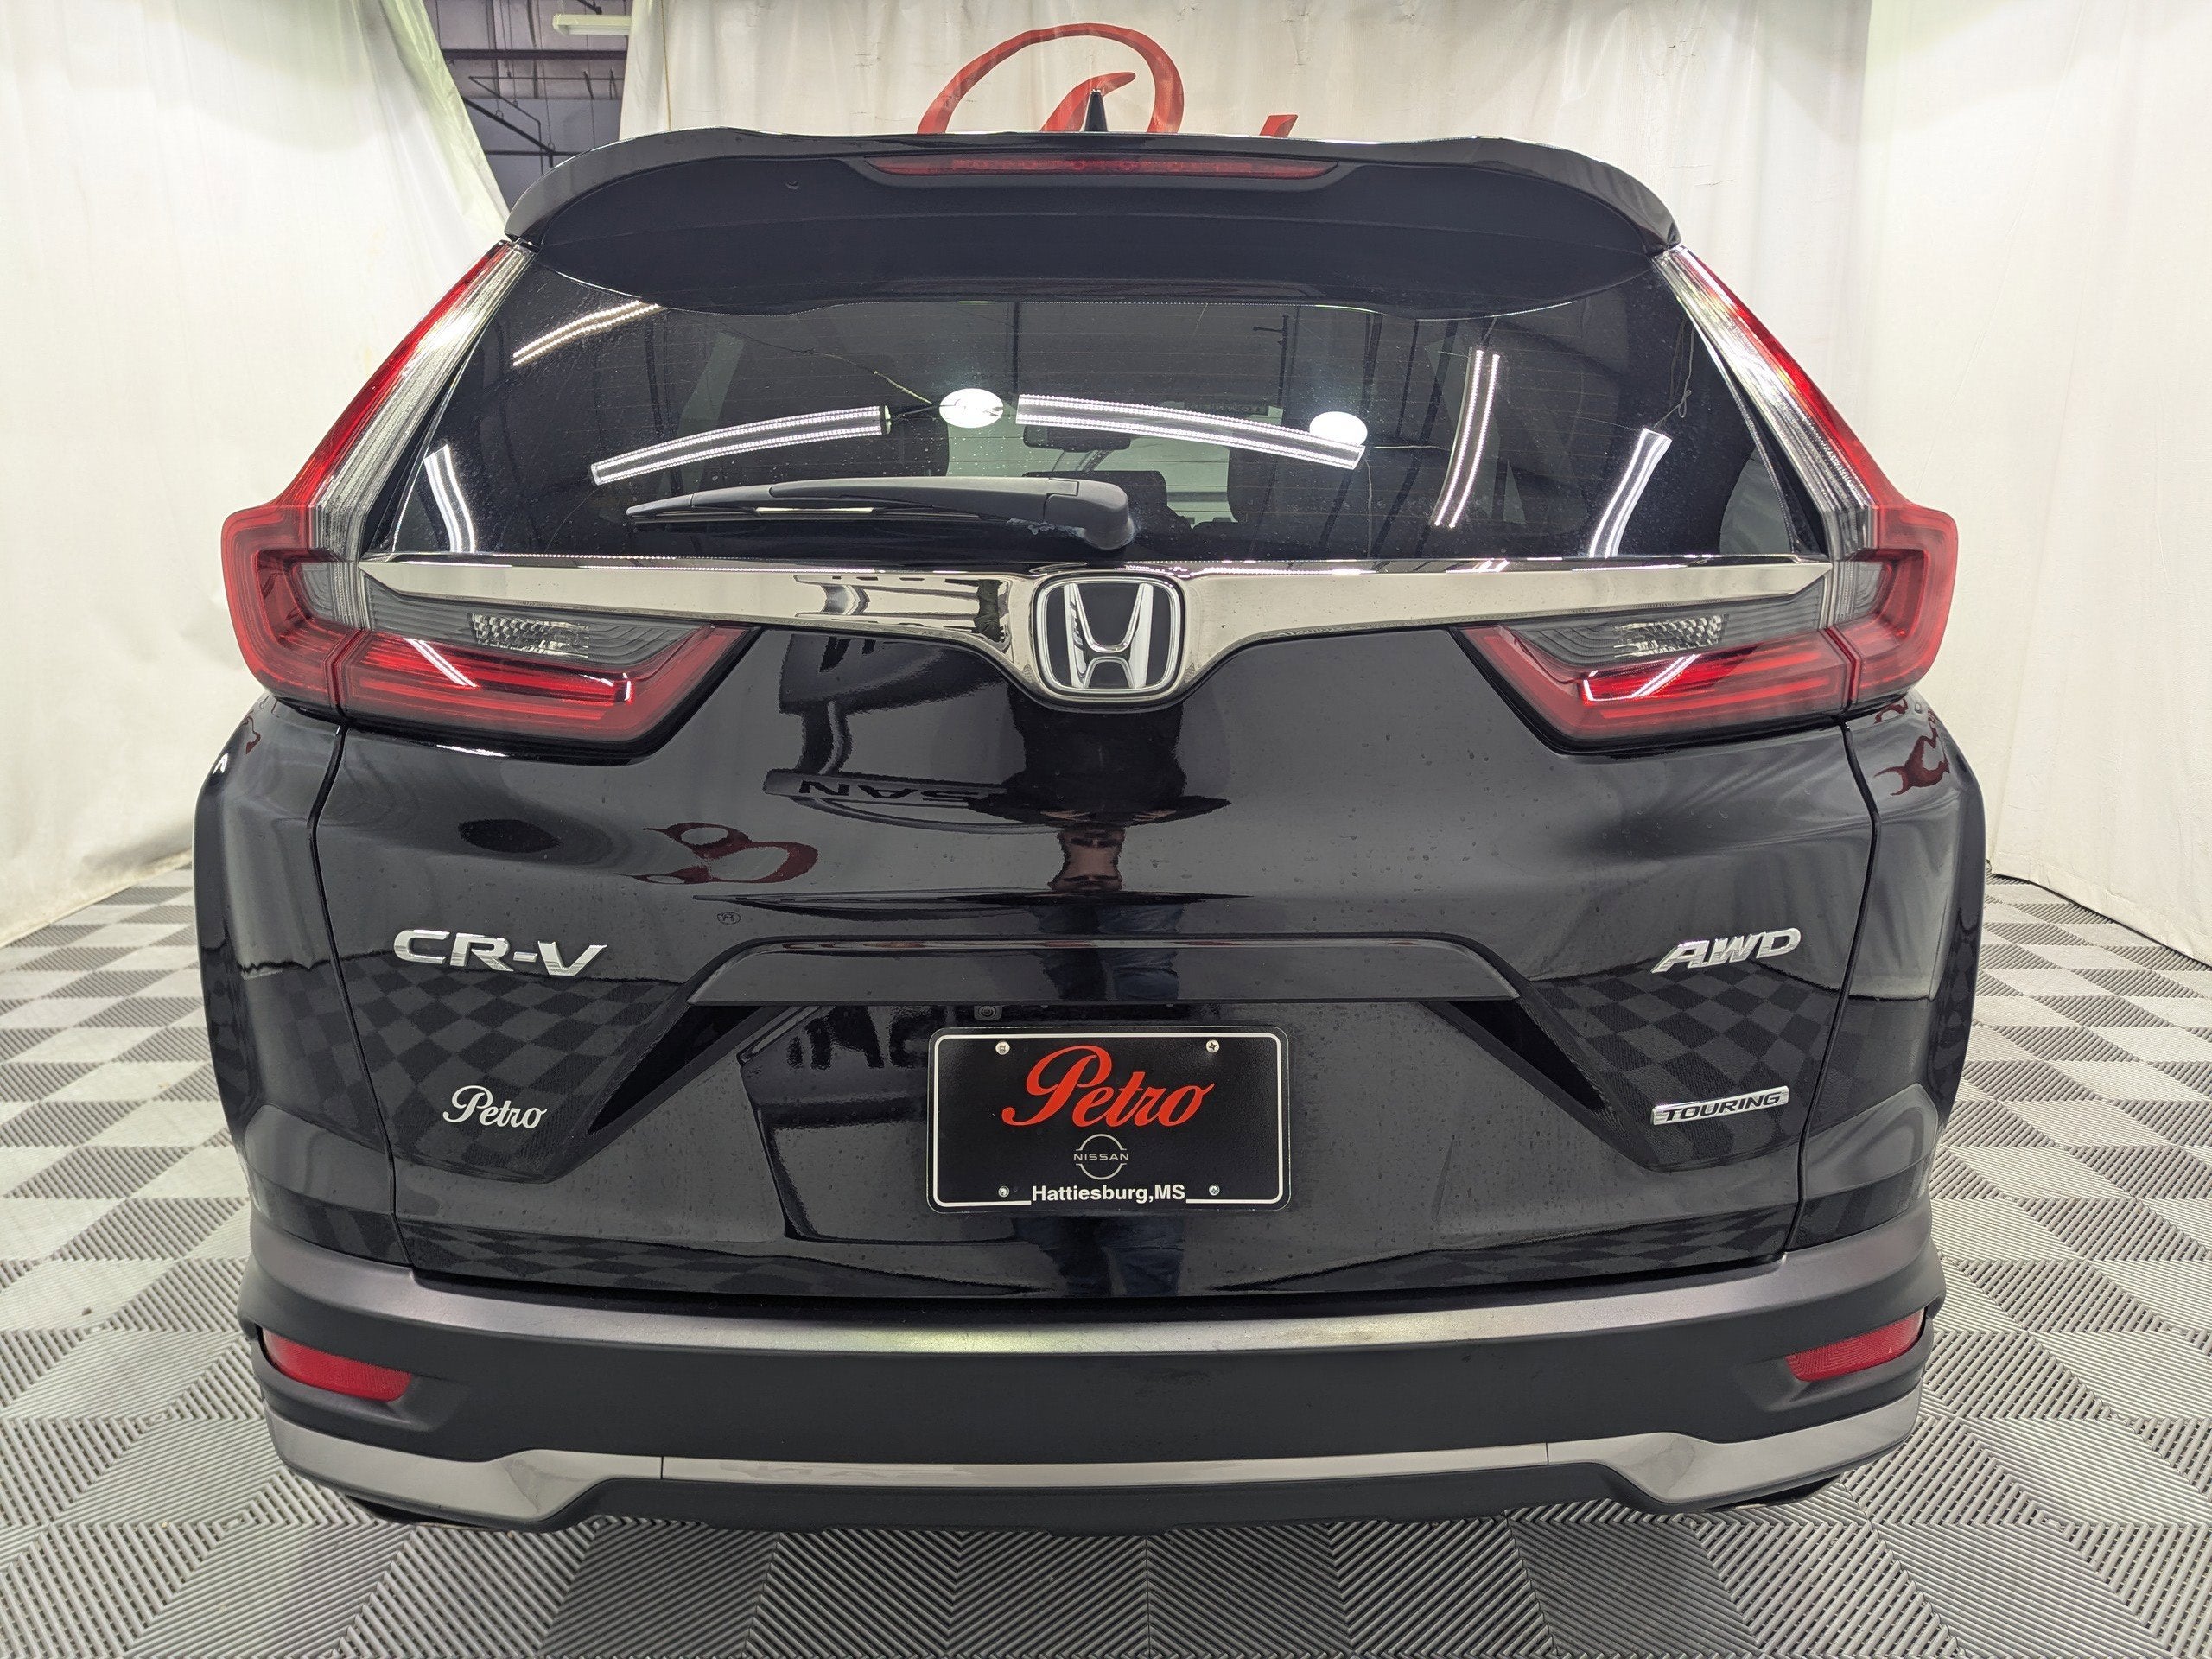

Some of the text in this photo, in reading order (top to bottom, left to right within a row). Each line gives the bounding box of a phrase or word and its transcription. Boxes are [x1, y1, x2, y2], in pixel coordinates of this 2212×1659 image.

[393, 929, 607, 977] CR-V
[1650, 927, 1802, 974] AWD
[442, 1084, 548, 1129] Petro
[1001, 1045, 1215, 1128] Petro
[1664, 1091, 1782, 1122] TOURING
[1073, 1153, 1129, 1161] NISSAN
[1032, 1184, 1185, 1204] Hattiesburg,MS
